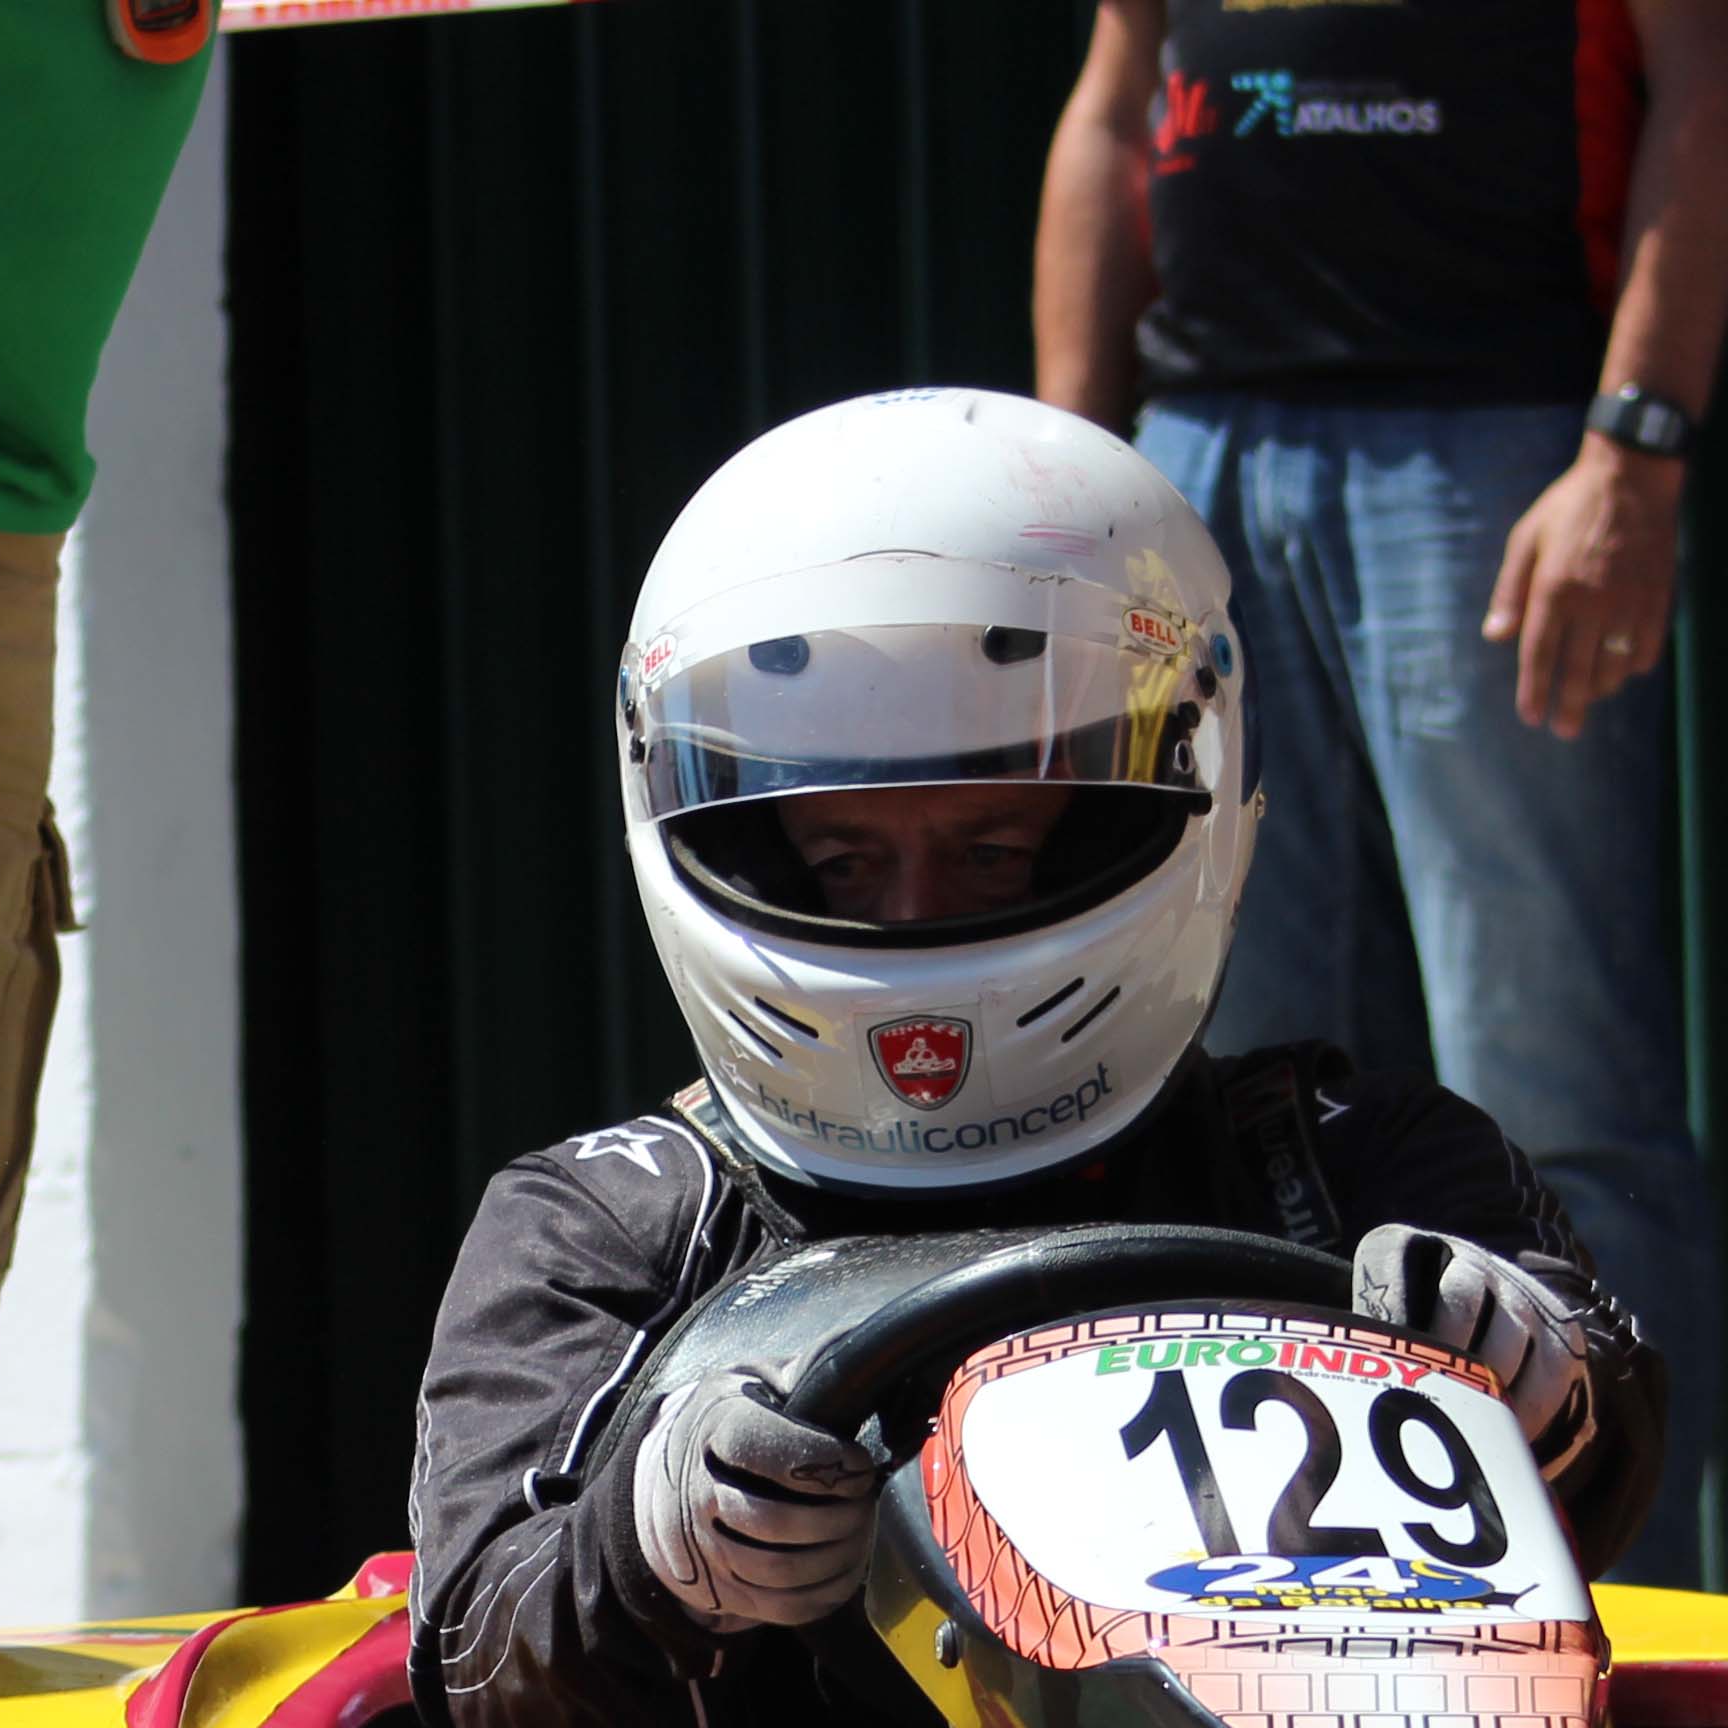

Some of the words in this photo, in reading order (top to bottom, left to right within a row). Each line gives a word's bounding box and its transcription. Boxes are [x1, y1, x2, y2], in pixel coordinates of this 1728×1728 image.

[1129, 612, 1177, 646] BELL
[644, 639, 672, 675] BELL
[756, 1061, 1114, 1156] hidrauliconcept
[1093, 1339, 1434, 1389] EUROINDY
[1118, 1368, 1509, 1568] 129
[1196, 1555, 1419, 1595] 24
